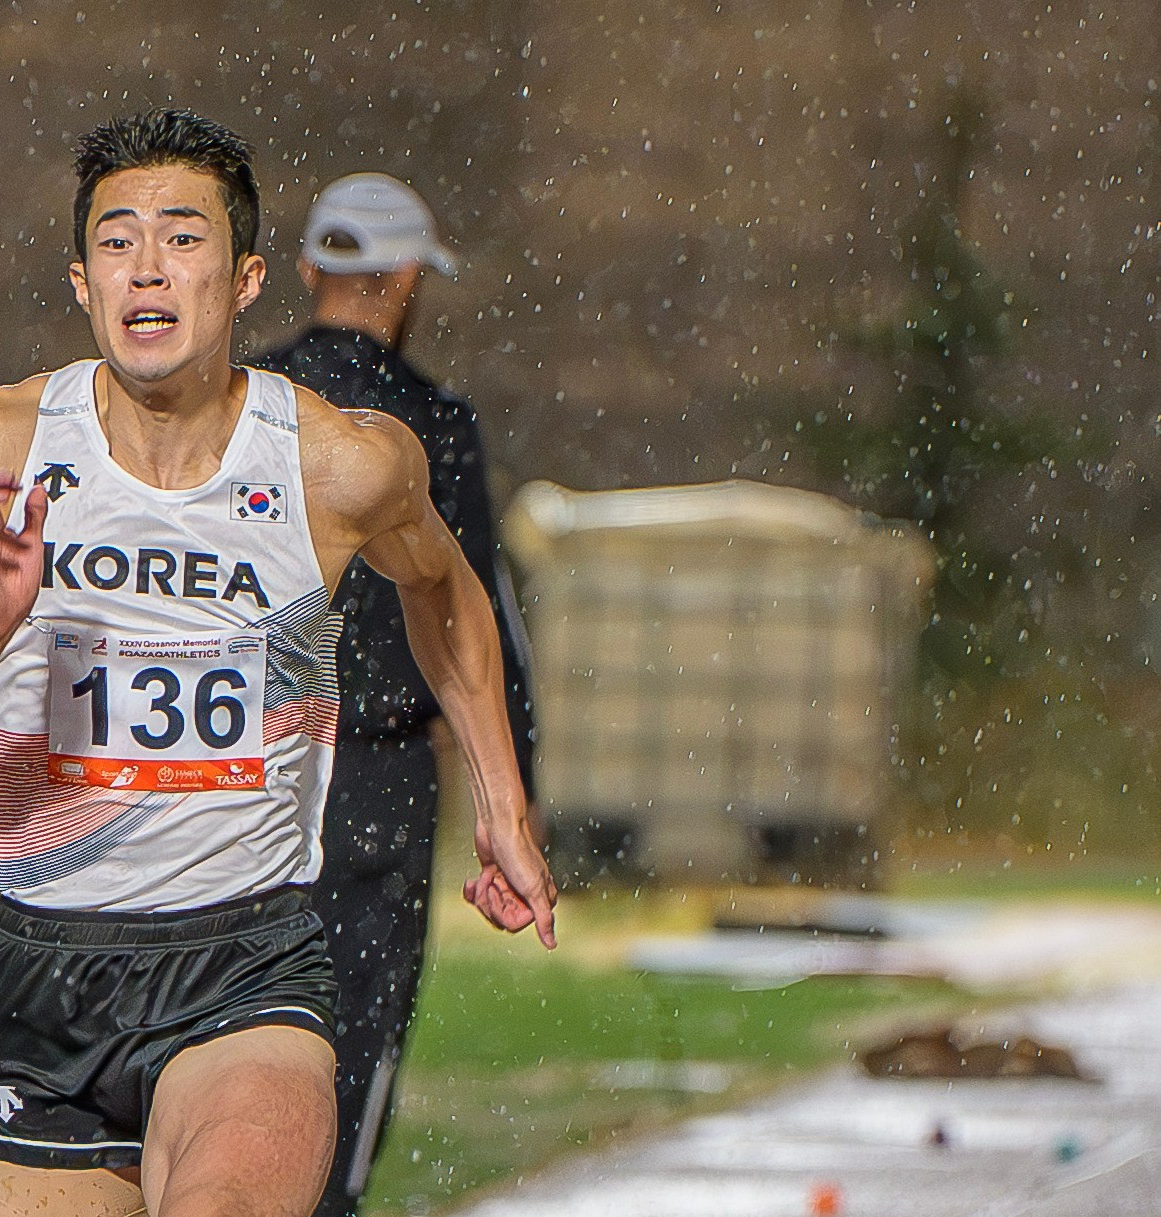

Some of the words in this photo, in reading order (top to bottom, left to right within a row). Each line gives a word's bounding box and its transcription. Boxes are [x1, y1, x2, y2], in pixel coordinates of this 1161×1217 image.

[41, 541, 271, 608] KOREA
[119, 639, 142, 648] XXXIV
[143, 640, 180, 648] Qosanov
[182, 638, 221, 647] Memorial
[119, 649, 221, 659] #QAZAQATHLETICS
[71, 665, 248, 750] 136
[215, 774, 258, 785] TASSAY
